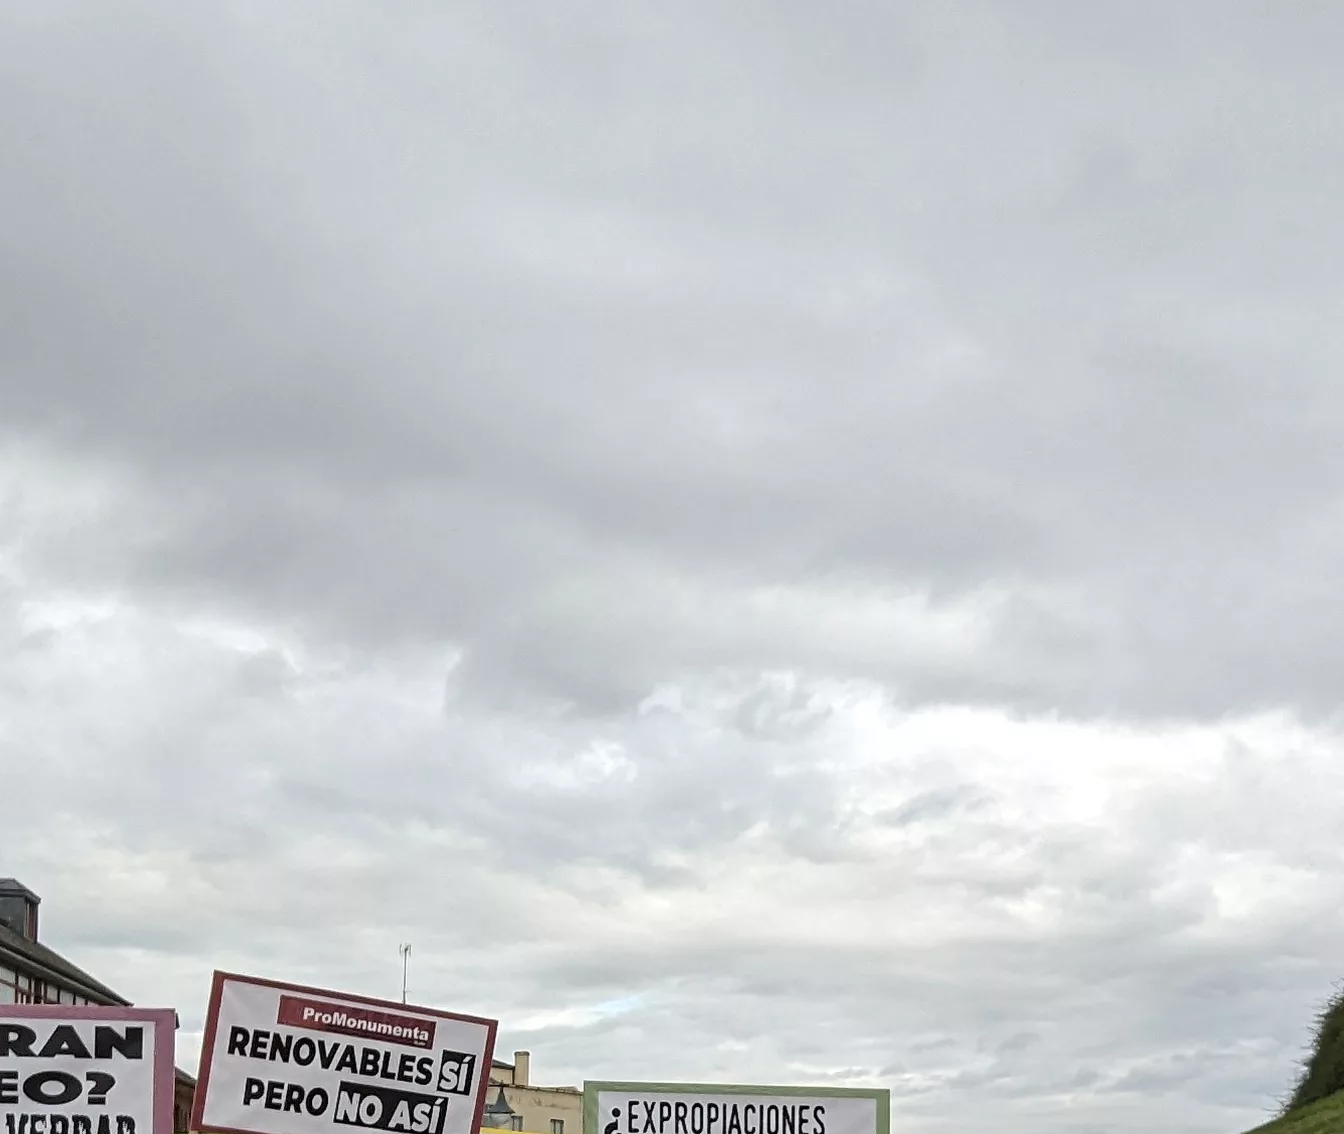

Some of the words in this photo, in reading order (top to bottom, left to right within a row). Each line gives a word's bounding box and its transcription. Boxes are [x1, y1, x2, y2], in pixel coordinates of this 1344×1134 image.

[302, 1006, 430, 1042] ProMonumenta
[227, 1025, 434, 1086] RENOVABLES
[438, 1056, 473, 1092] SÍ
[243, 1077, 329, 1117] PERO
[335, 1090, 383, 1125] NO
[387, 1097, 447, 1134] ASÍ
